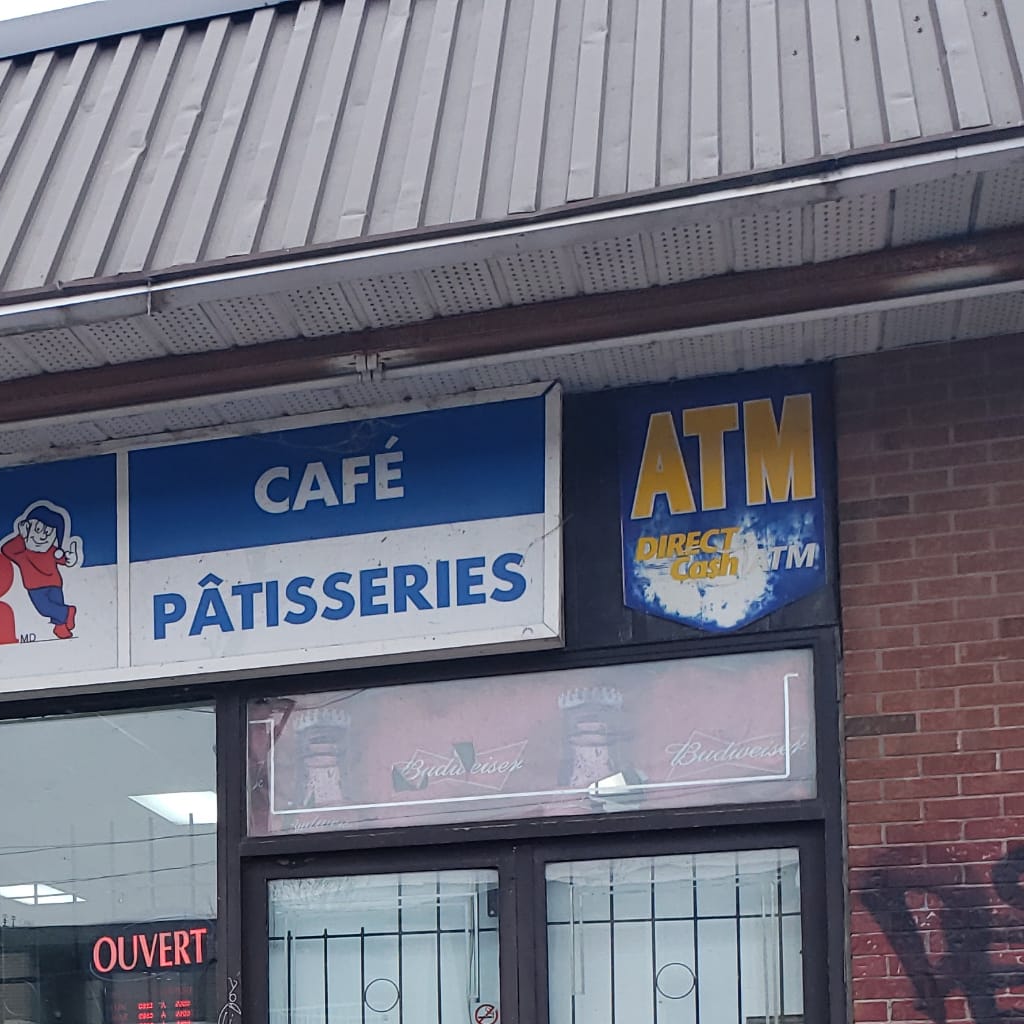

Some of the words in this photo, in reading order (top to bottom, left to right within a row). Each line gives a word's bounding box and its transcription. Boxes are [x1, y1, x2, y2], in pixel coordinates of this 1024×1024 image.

[254, 435, 405, 514] CAFÉ
[631, 393, 816, 520] ATM
[636, 527, 741, 561] DIRECT
[670, 553, 740, 581] Cash
[153, 553, 527, 640] PÂTISSERIES
[20, 633, 37, 643] MD
[93, 927, 208, 973] OUVERT
